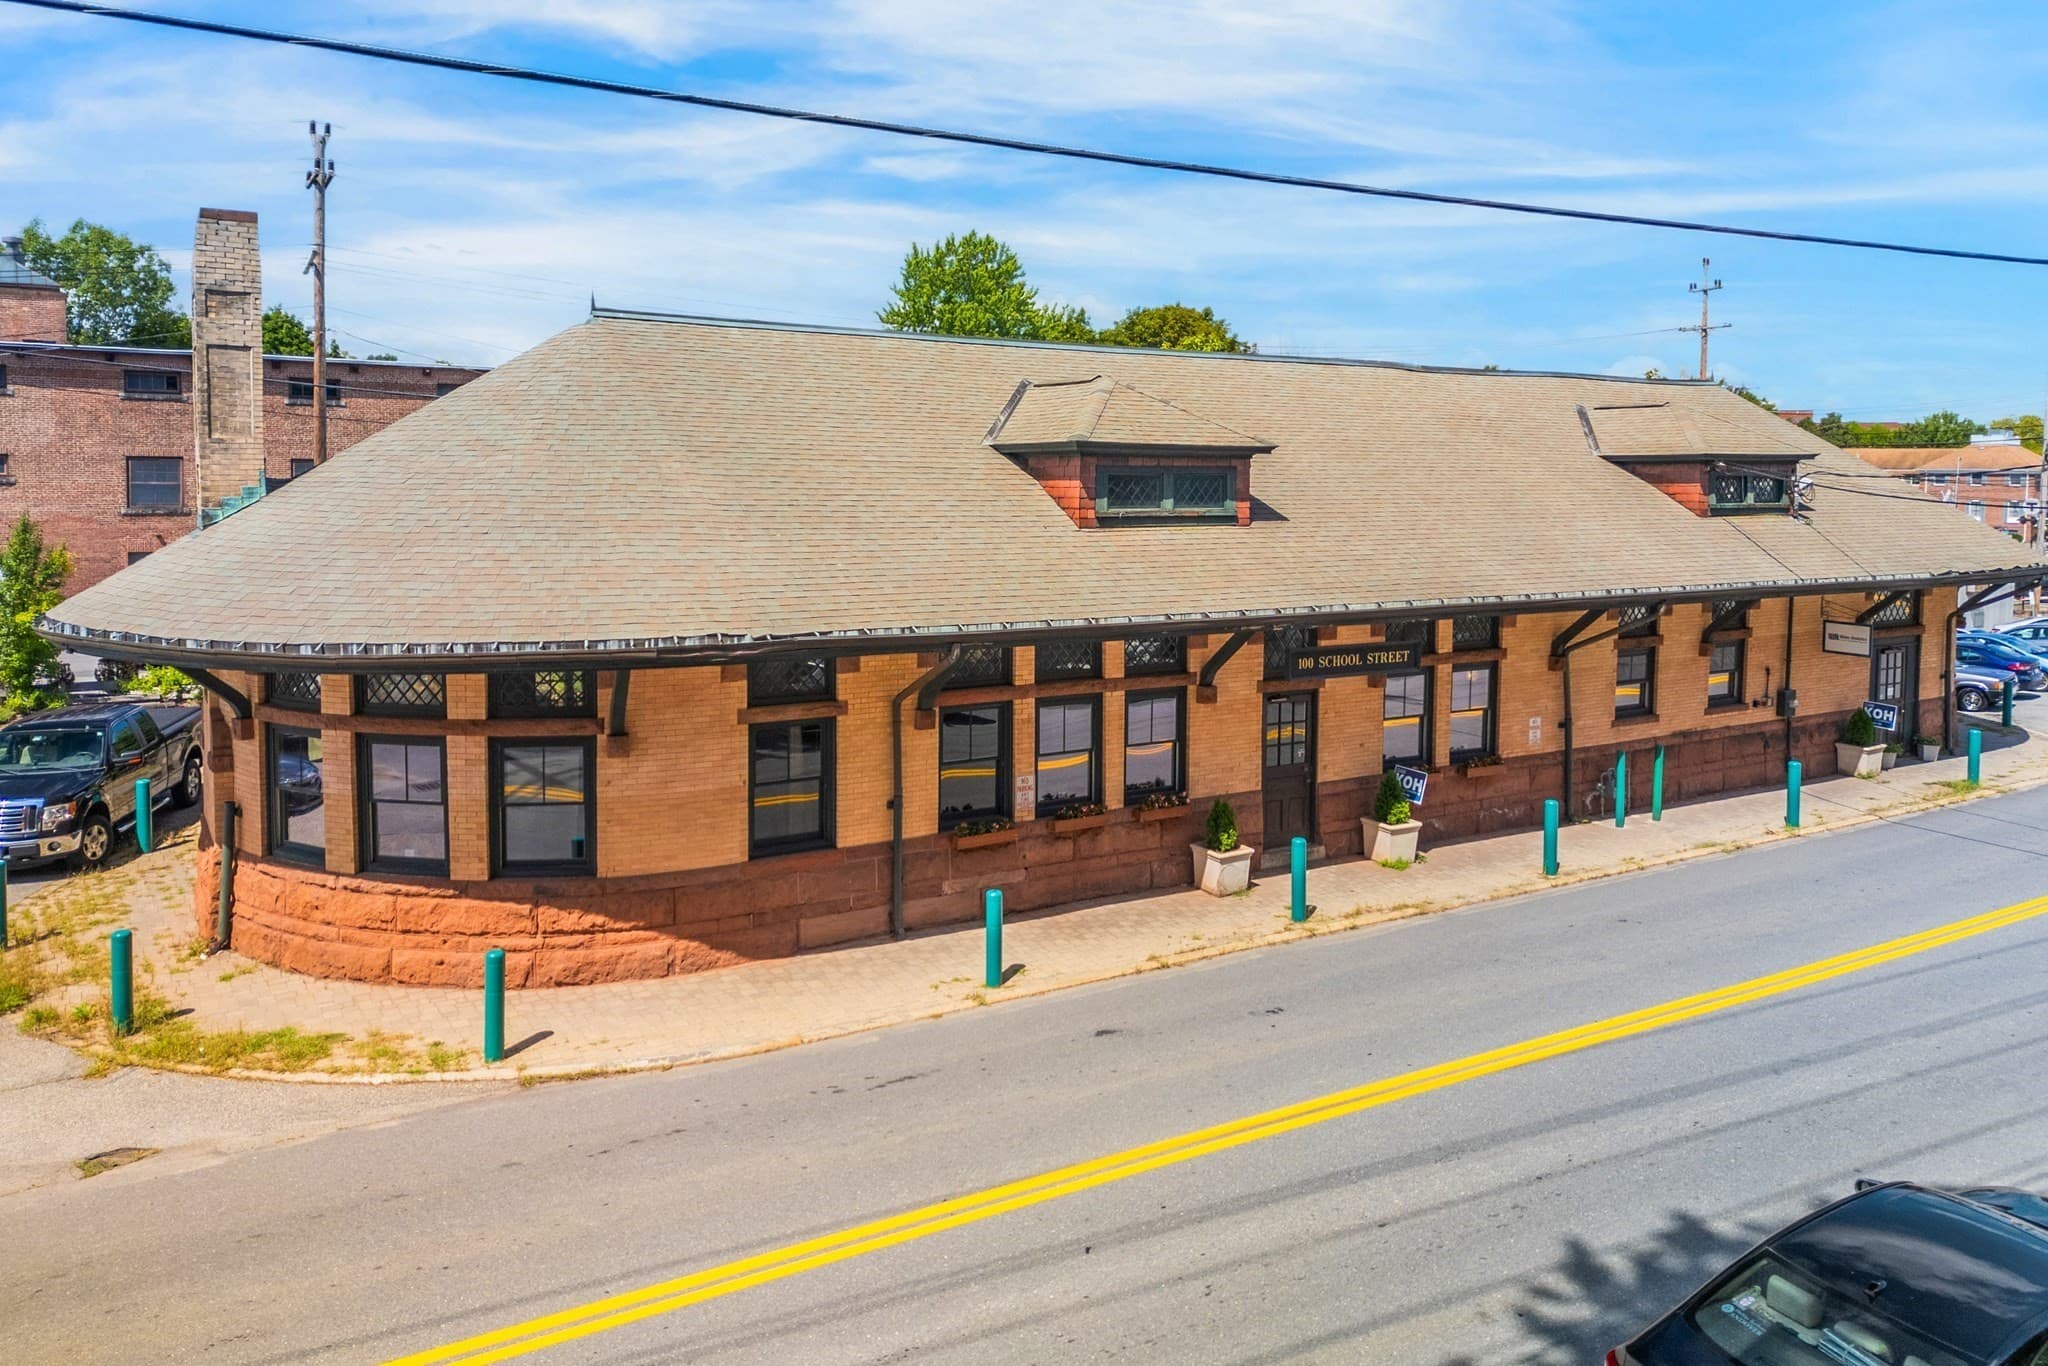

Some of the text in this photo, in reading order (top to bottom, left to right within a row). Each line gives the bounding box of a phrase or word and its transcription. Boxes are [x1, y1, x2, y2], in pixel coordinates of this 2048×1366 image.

[1298, 650, 1410, 670] 100 SCHOOL STREET
